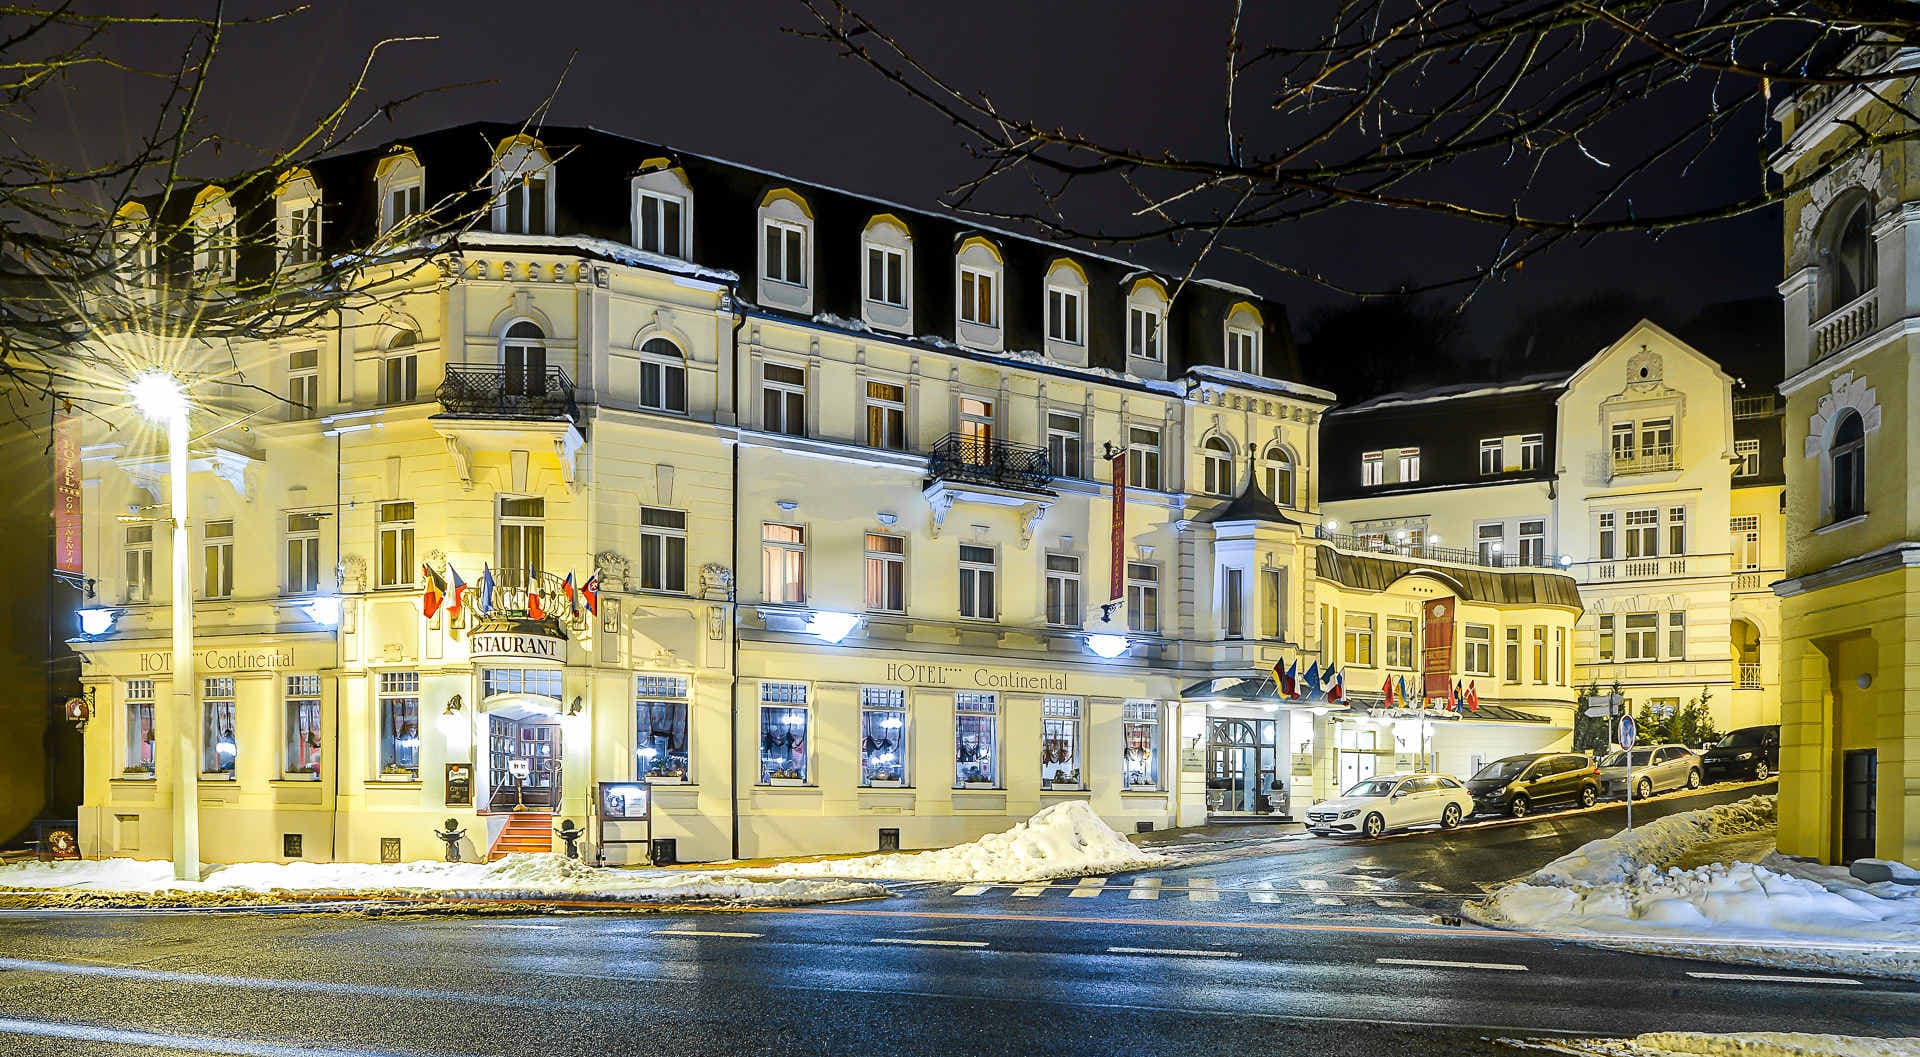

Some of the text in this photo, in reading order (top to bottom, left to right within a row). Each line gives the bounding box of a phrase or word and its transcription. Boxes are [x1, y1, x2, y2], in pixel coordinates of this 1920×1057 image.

[470, 636, 557, 656] ESTAURANT
[140, 648, 295, 671] HOT Continental
[887, 663, 1068, 690] HOTEL Continental
